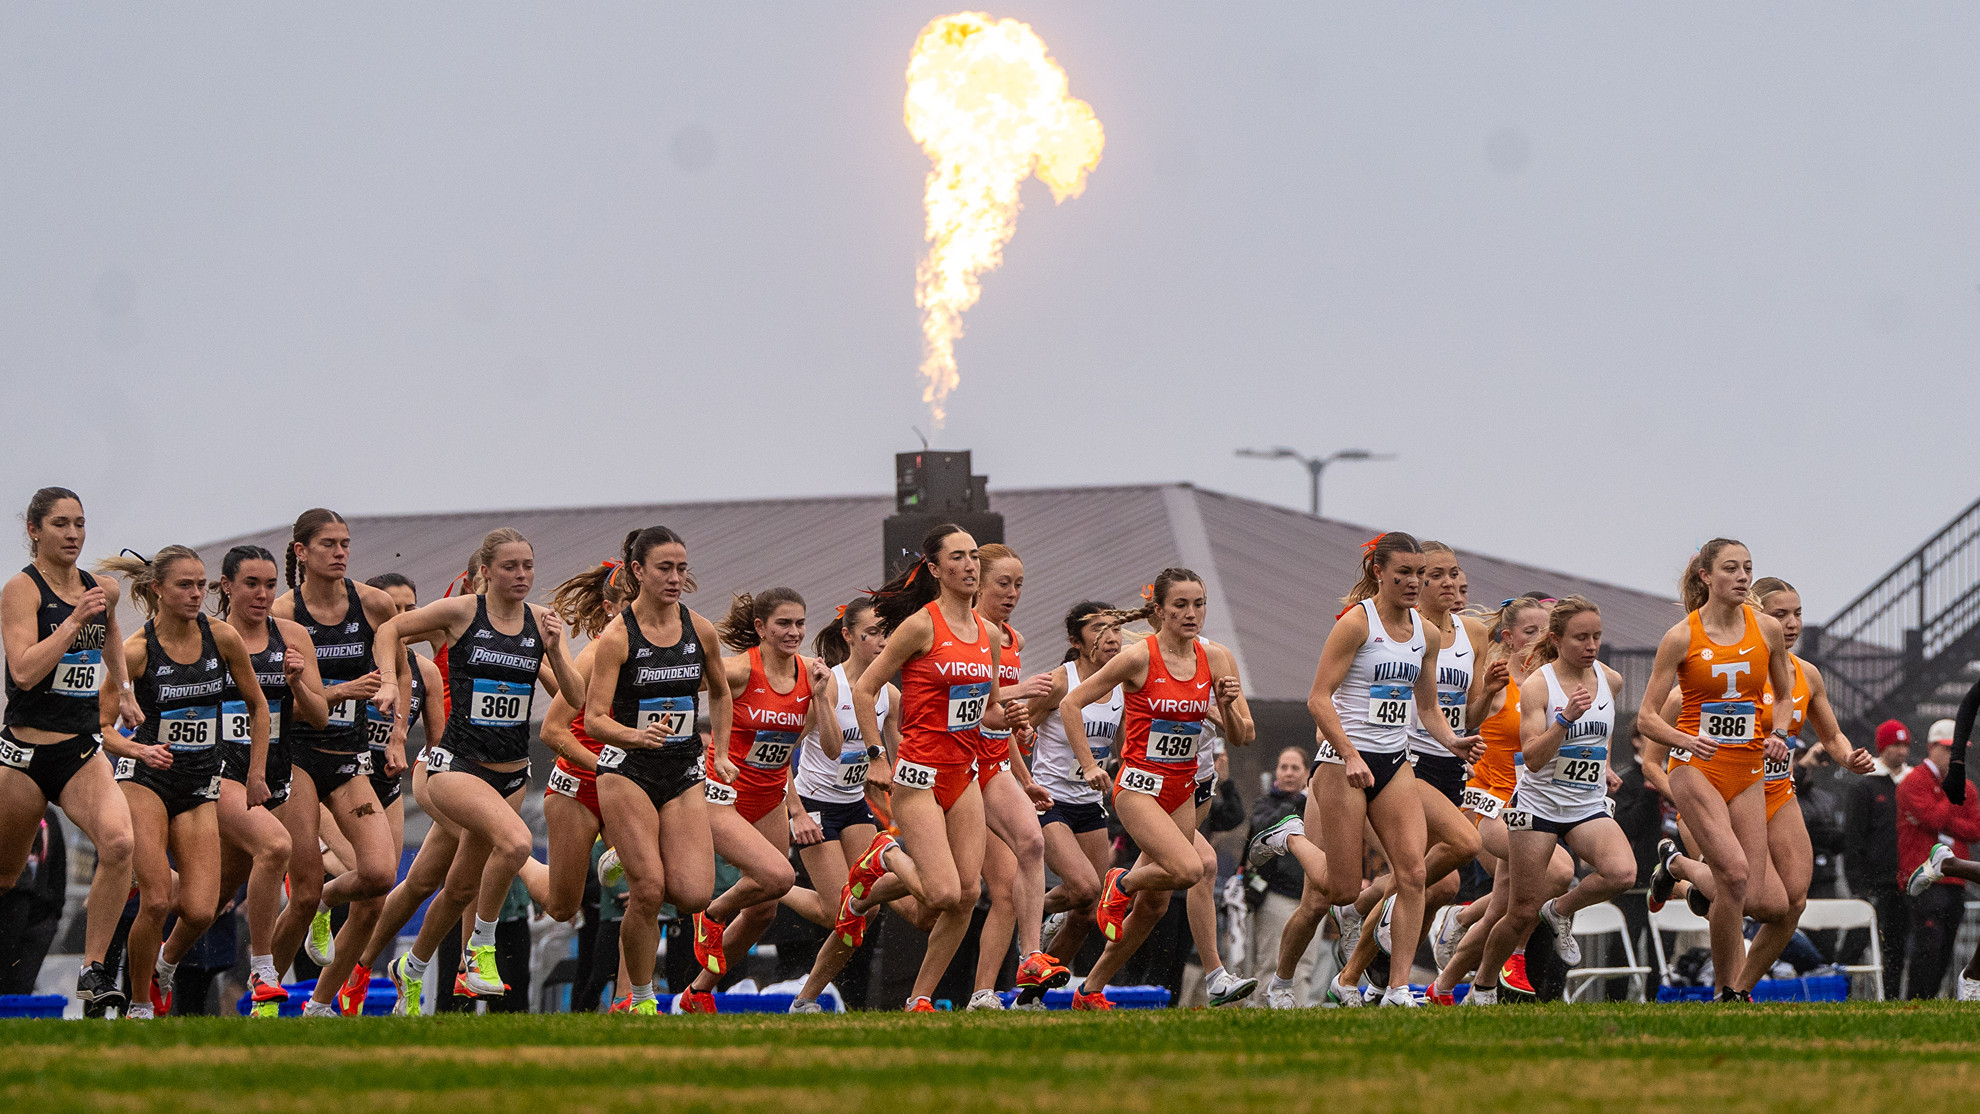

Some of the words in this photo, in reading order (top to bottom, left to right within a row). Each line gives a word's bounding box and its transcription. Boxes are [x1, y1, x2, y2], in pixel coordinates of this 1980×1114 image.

[315, 643, 363, 659] OVIDENCE
[468, 647, 538, 672] PROVIDENCE
[62, 666, 95, 689] 456
[634, 664, 700, 686] PROVIDENCE
[1437, 667, 1469, 692] ANOVA
[1711, 661, 1751, 699] T
[158, 679, 223, 702] PROVIDENCE
[481, 695, 520, 719] 360
[956, 697, 985, 722] 438
[1147, 697, 1209, 713] VIRGINI
[1376, 701, 1407, 723] 434
[168, 721, 208, 743] 356
[1708, 715, 1747, 737] 386
[755, 744, 791, 763] 435
[1155, 735, 1193, 756] 439
[843, 763, 869, 785] 432
[898, 765, 929, 786] 438
[1125, 772, 1156, 791] 439
[1563, 760, 1600, 782] 423
